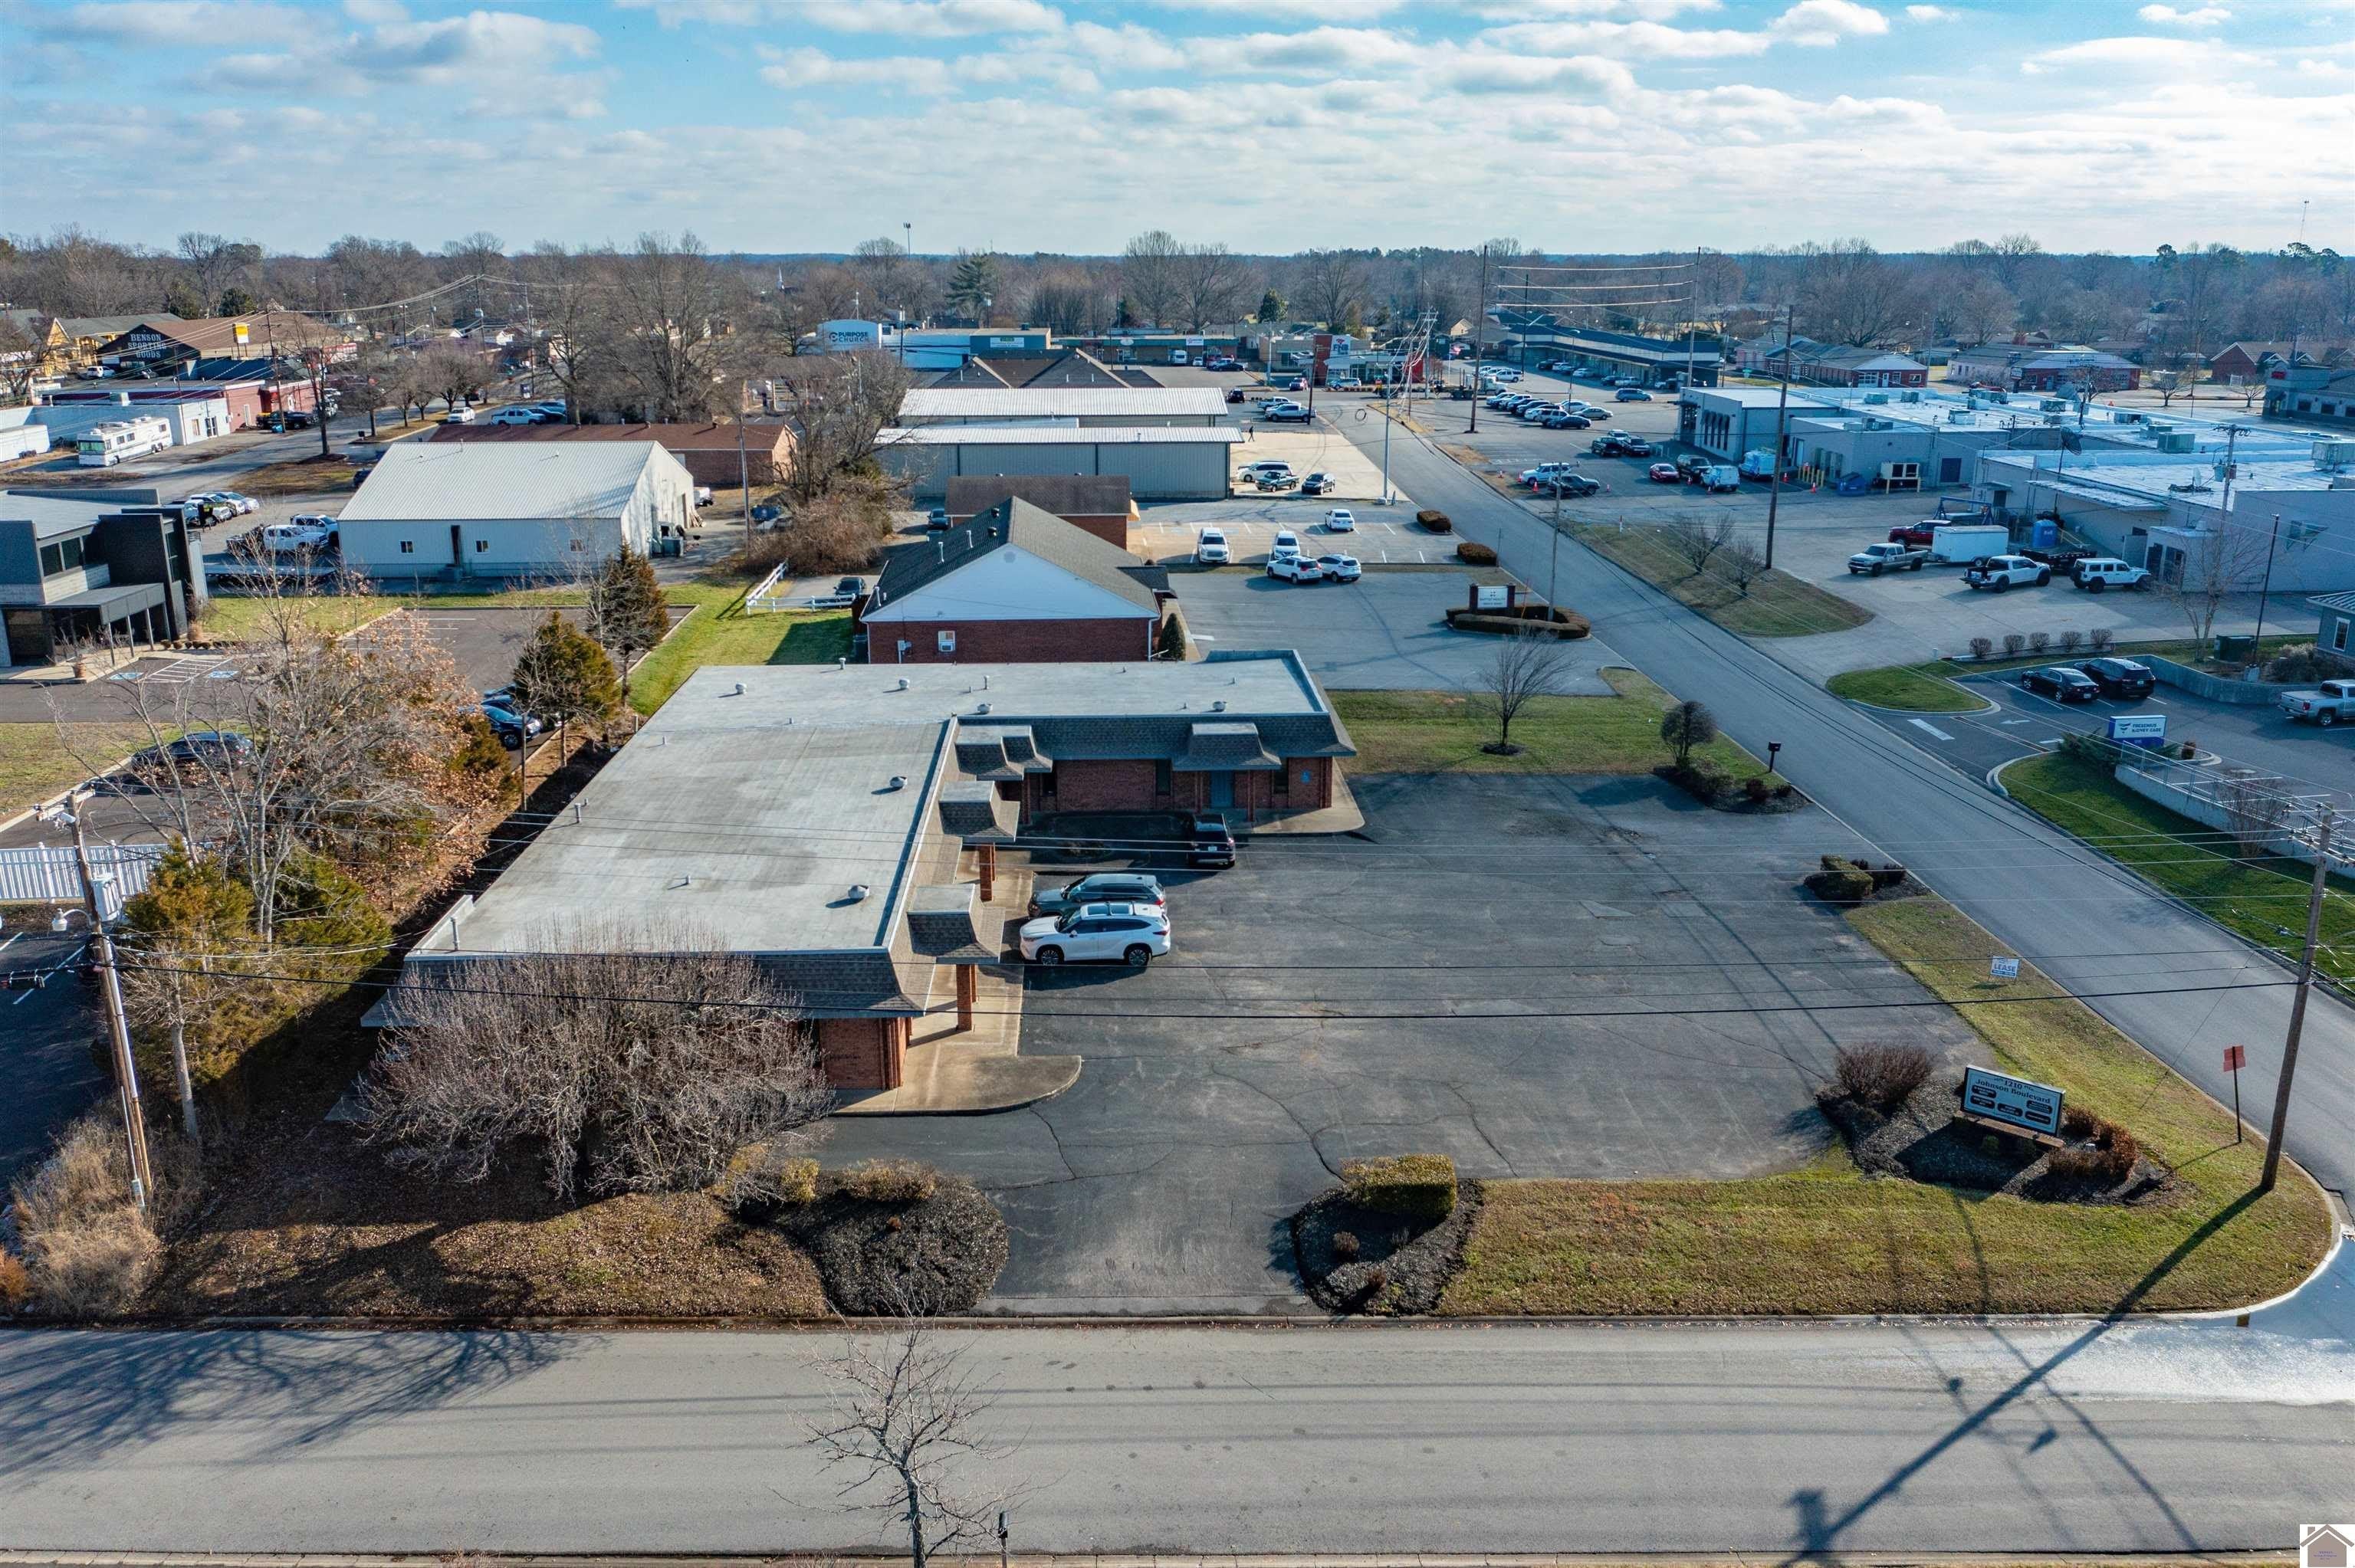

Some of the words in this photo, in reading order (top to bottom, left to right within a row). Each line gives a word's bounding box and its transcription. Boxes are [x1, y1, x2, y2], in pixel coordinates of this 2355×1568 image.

[130, 333, 161, 342] BENSON
[1994, 963, 2016, 972] LEASE
[2004, 1080, 2022, 1090] 1210
[1976, 1079, 2008, 1092] Johnson
[2011, 1088, 2050, 1104] Boulevard
